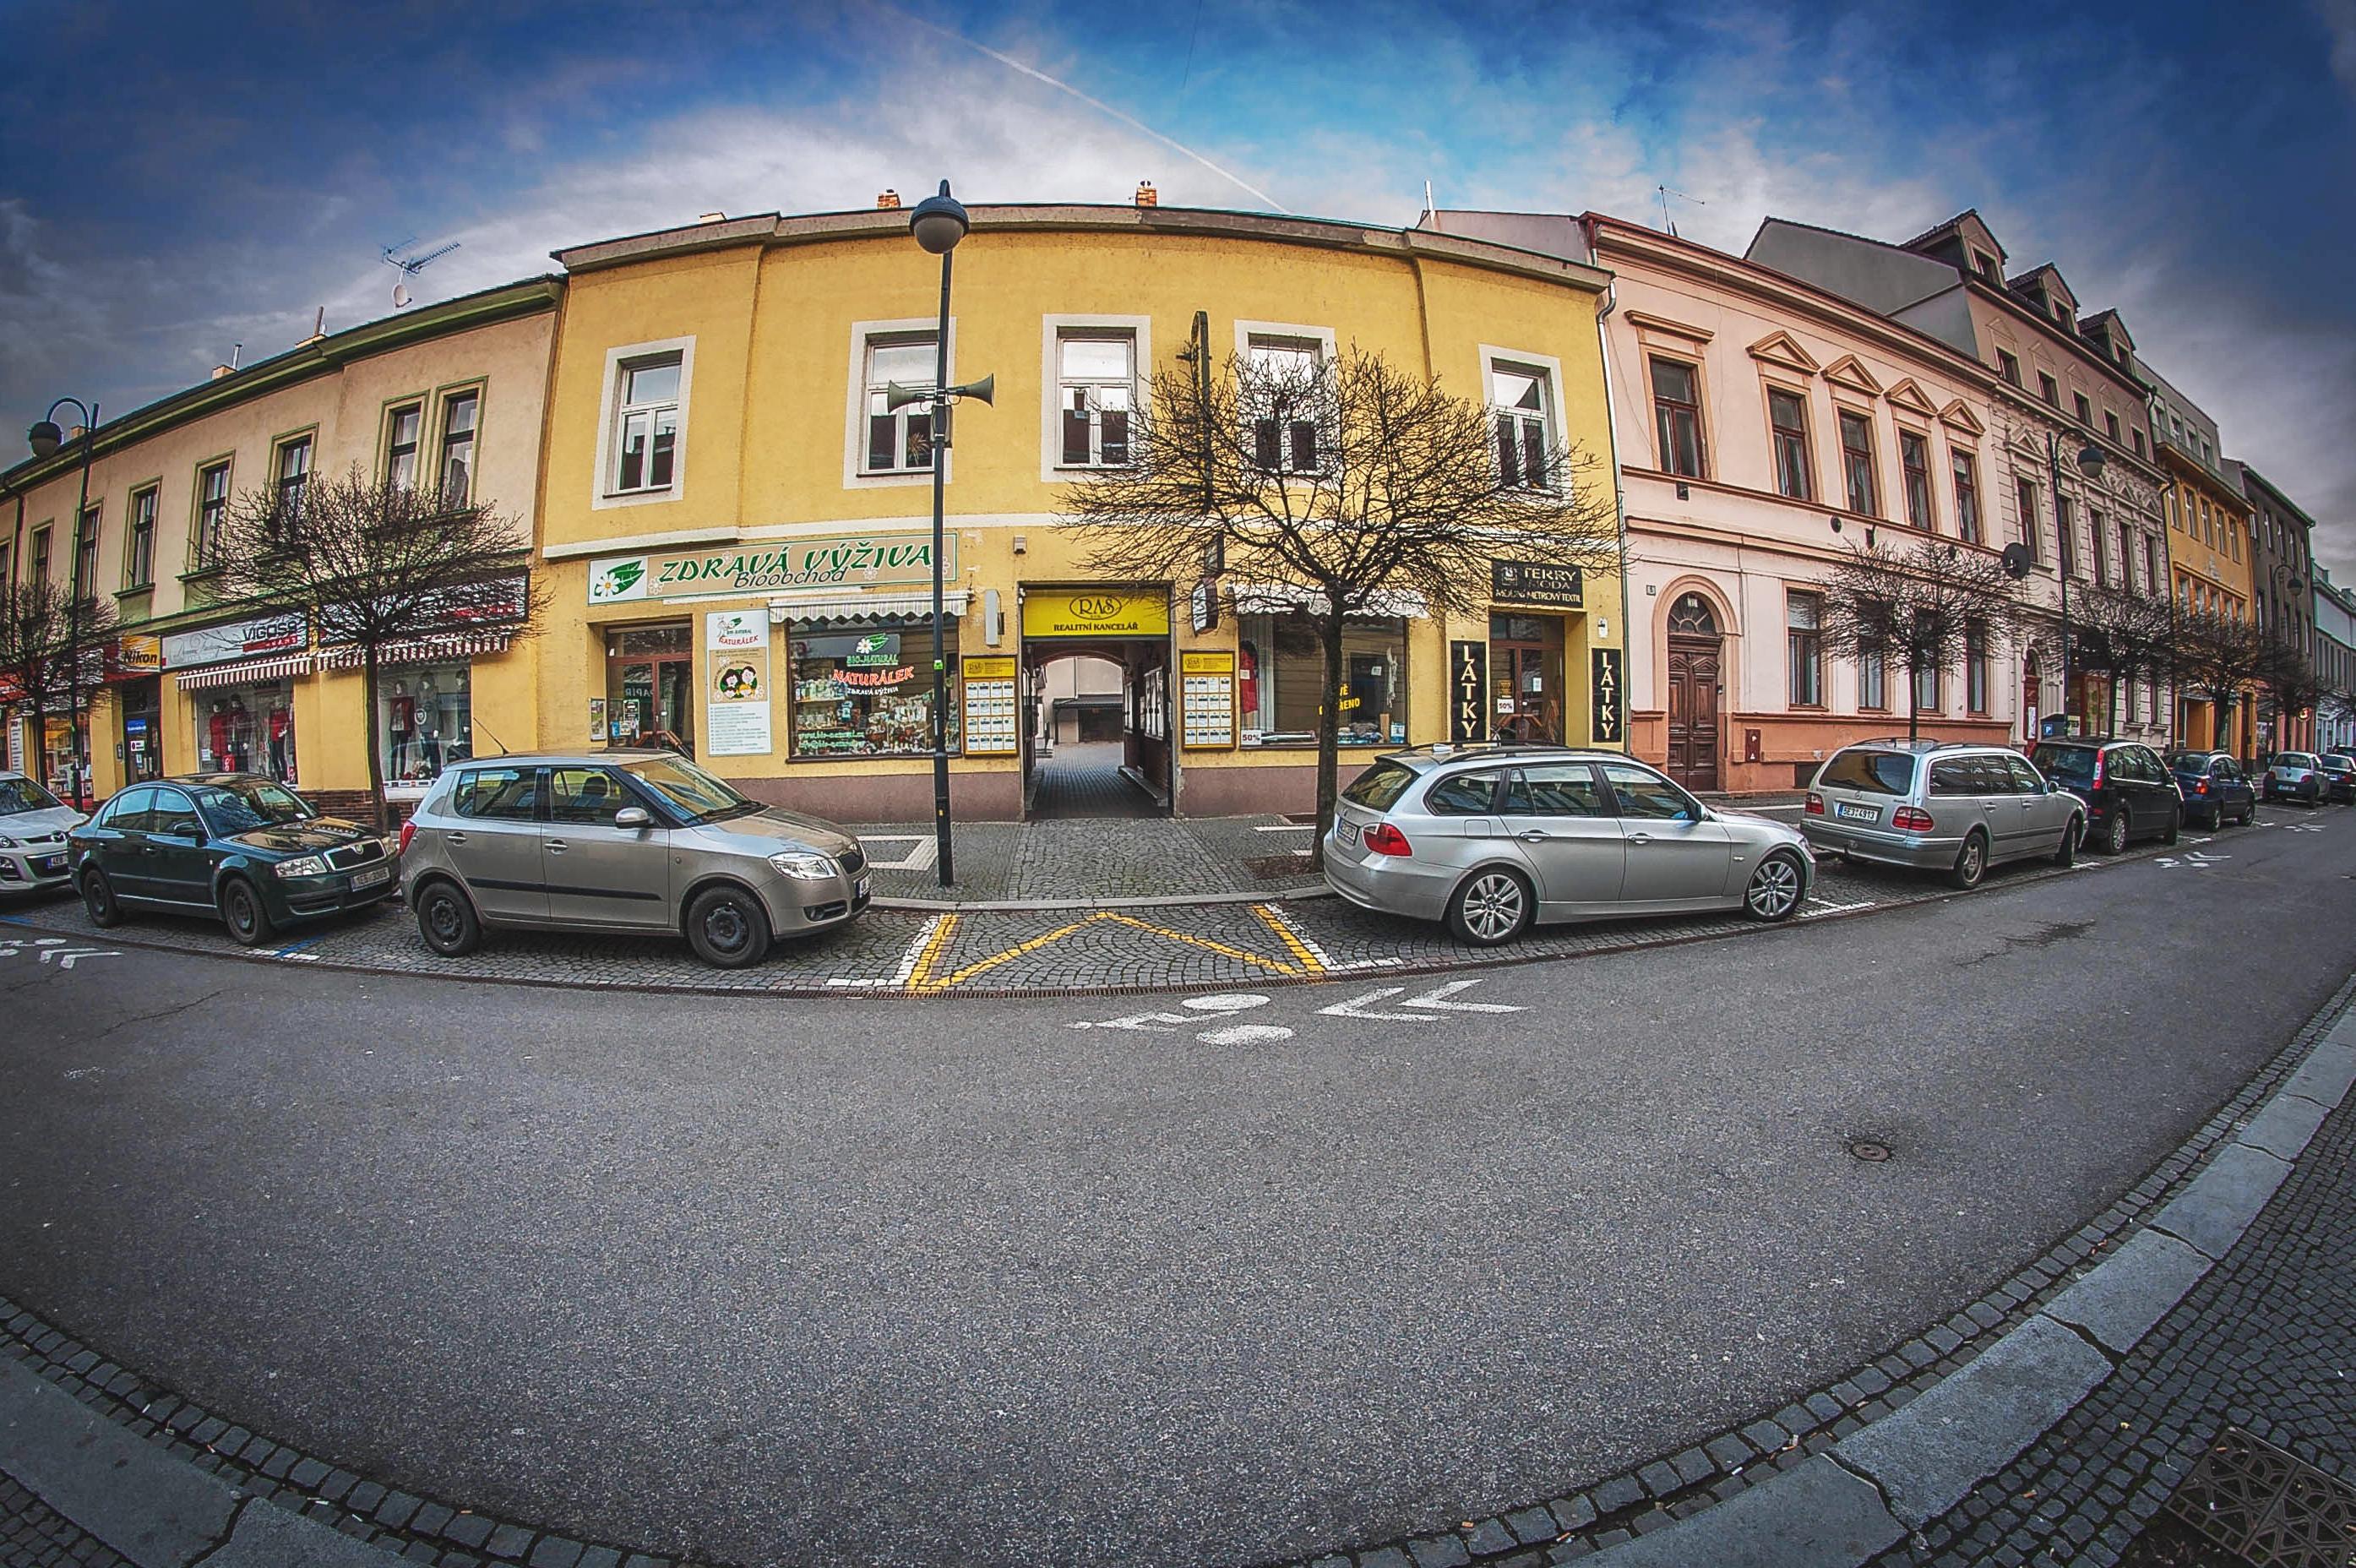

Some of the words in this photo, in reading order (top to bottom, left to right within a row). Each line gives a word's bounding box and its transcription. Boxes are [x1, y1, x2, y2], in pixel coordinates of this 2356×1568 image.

[658, 547, 787, 584] ZDRAVÁ
[803, 542, 931, 574] VÝŽIVA
[733, 566, 850, 589] Bioobchod
[1524, 567, 1576, 581] TERRY
[1562, 592, 1582, 602] TEXTIL
[1053, 623, 1092, 631] REALITNÍ
[1093, 622, 1139, 630] KANCELÁŘ
[123, 650, 158, 664] Nikon
[832, 666, 915, 686] NATURÁLEK
[874, 686, 899, 695] VÝŽIVA
[1461, 645, 1477, 738] LÁTKY
[1601, 652, 1614, 739] LÁTKY
[1858, 809, 1875, 819] 4913
